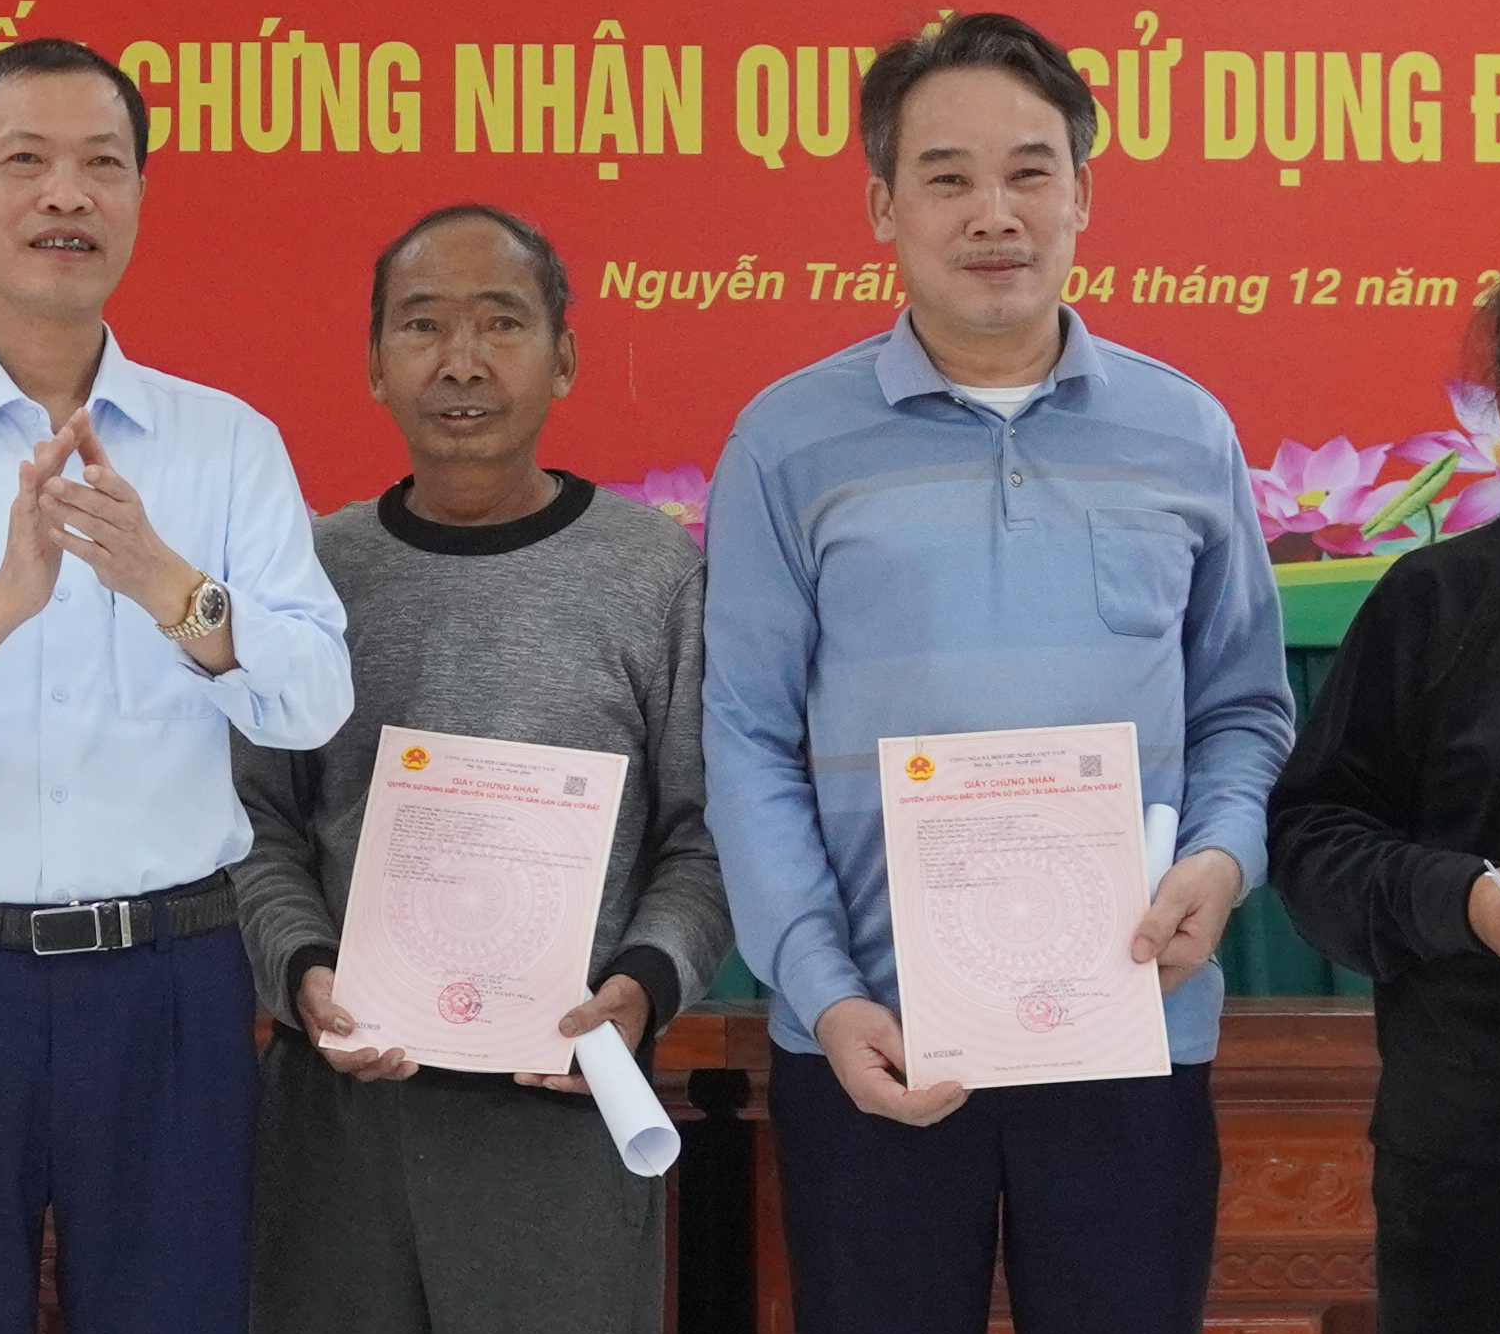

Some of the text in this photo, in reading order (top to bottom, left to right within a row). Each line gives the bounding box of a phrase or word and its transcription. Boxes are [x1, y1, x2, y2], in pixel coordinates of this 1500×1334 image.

[119, 17, 422, 154] CHỨNG
[454, 20, 702, 180] NHẬN
[1203, 49, 1442, 186] DỤNG
[600, 254, 785, 309] Nguyễn
[805, 262, 906, 308] Trãi,
[1060, 265, 1115, 303] 04
[1132, 265, 1269, 314] tháng
[1288, 267, 1342, 305] 12
[1355, 269, 1458, 306] năm
